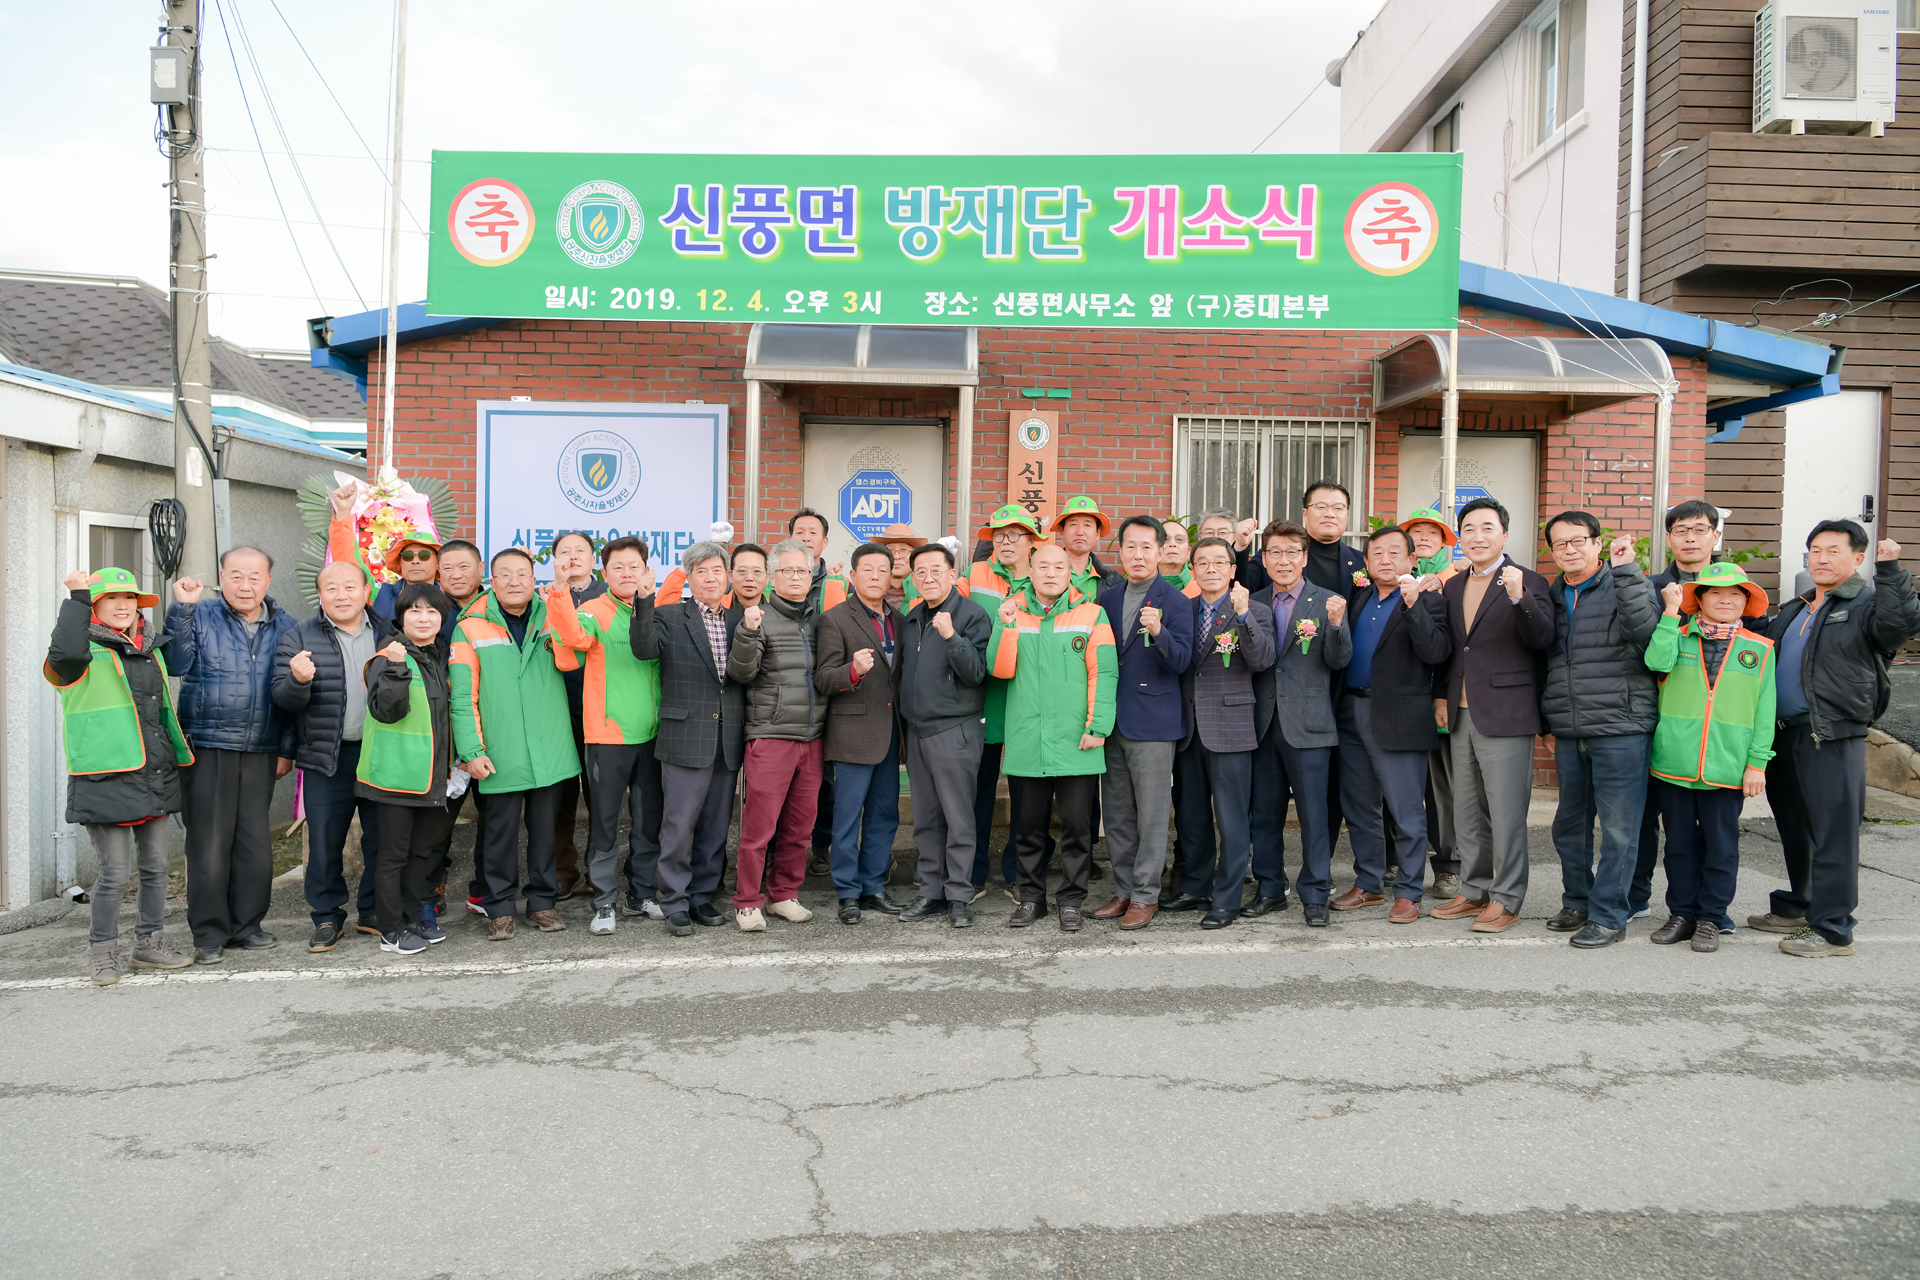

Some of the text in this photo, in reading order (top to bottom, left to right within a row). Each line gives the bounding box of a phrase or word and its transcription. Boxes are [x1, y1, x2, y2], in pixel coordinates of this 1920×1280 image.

[464, 193, 520, 253] 축
[562, 185, 639, 239] CITIZEN CORPS ACTIVE IN DISASTER
[659, 184, 1317, 260] 신풍면 방재단 개소식
[1361, 198, 1422, 262] 축
[566, 240, 631, 264] 공주시자율방재단
[544, 285, 1330, 319] 일시: 2019. 12. 4. 오후 3시 장소: 신풍면사무소 앞 (구)중대본부
[562, 434, 637, 487] CITIZEN CORPS ACTIVE IN DISASTER
[851, 493, 900, 519] ADT
